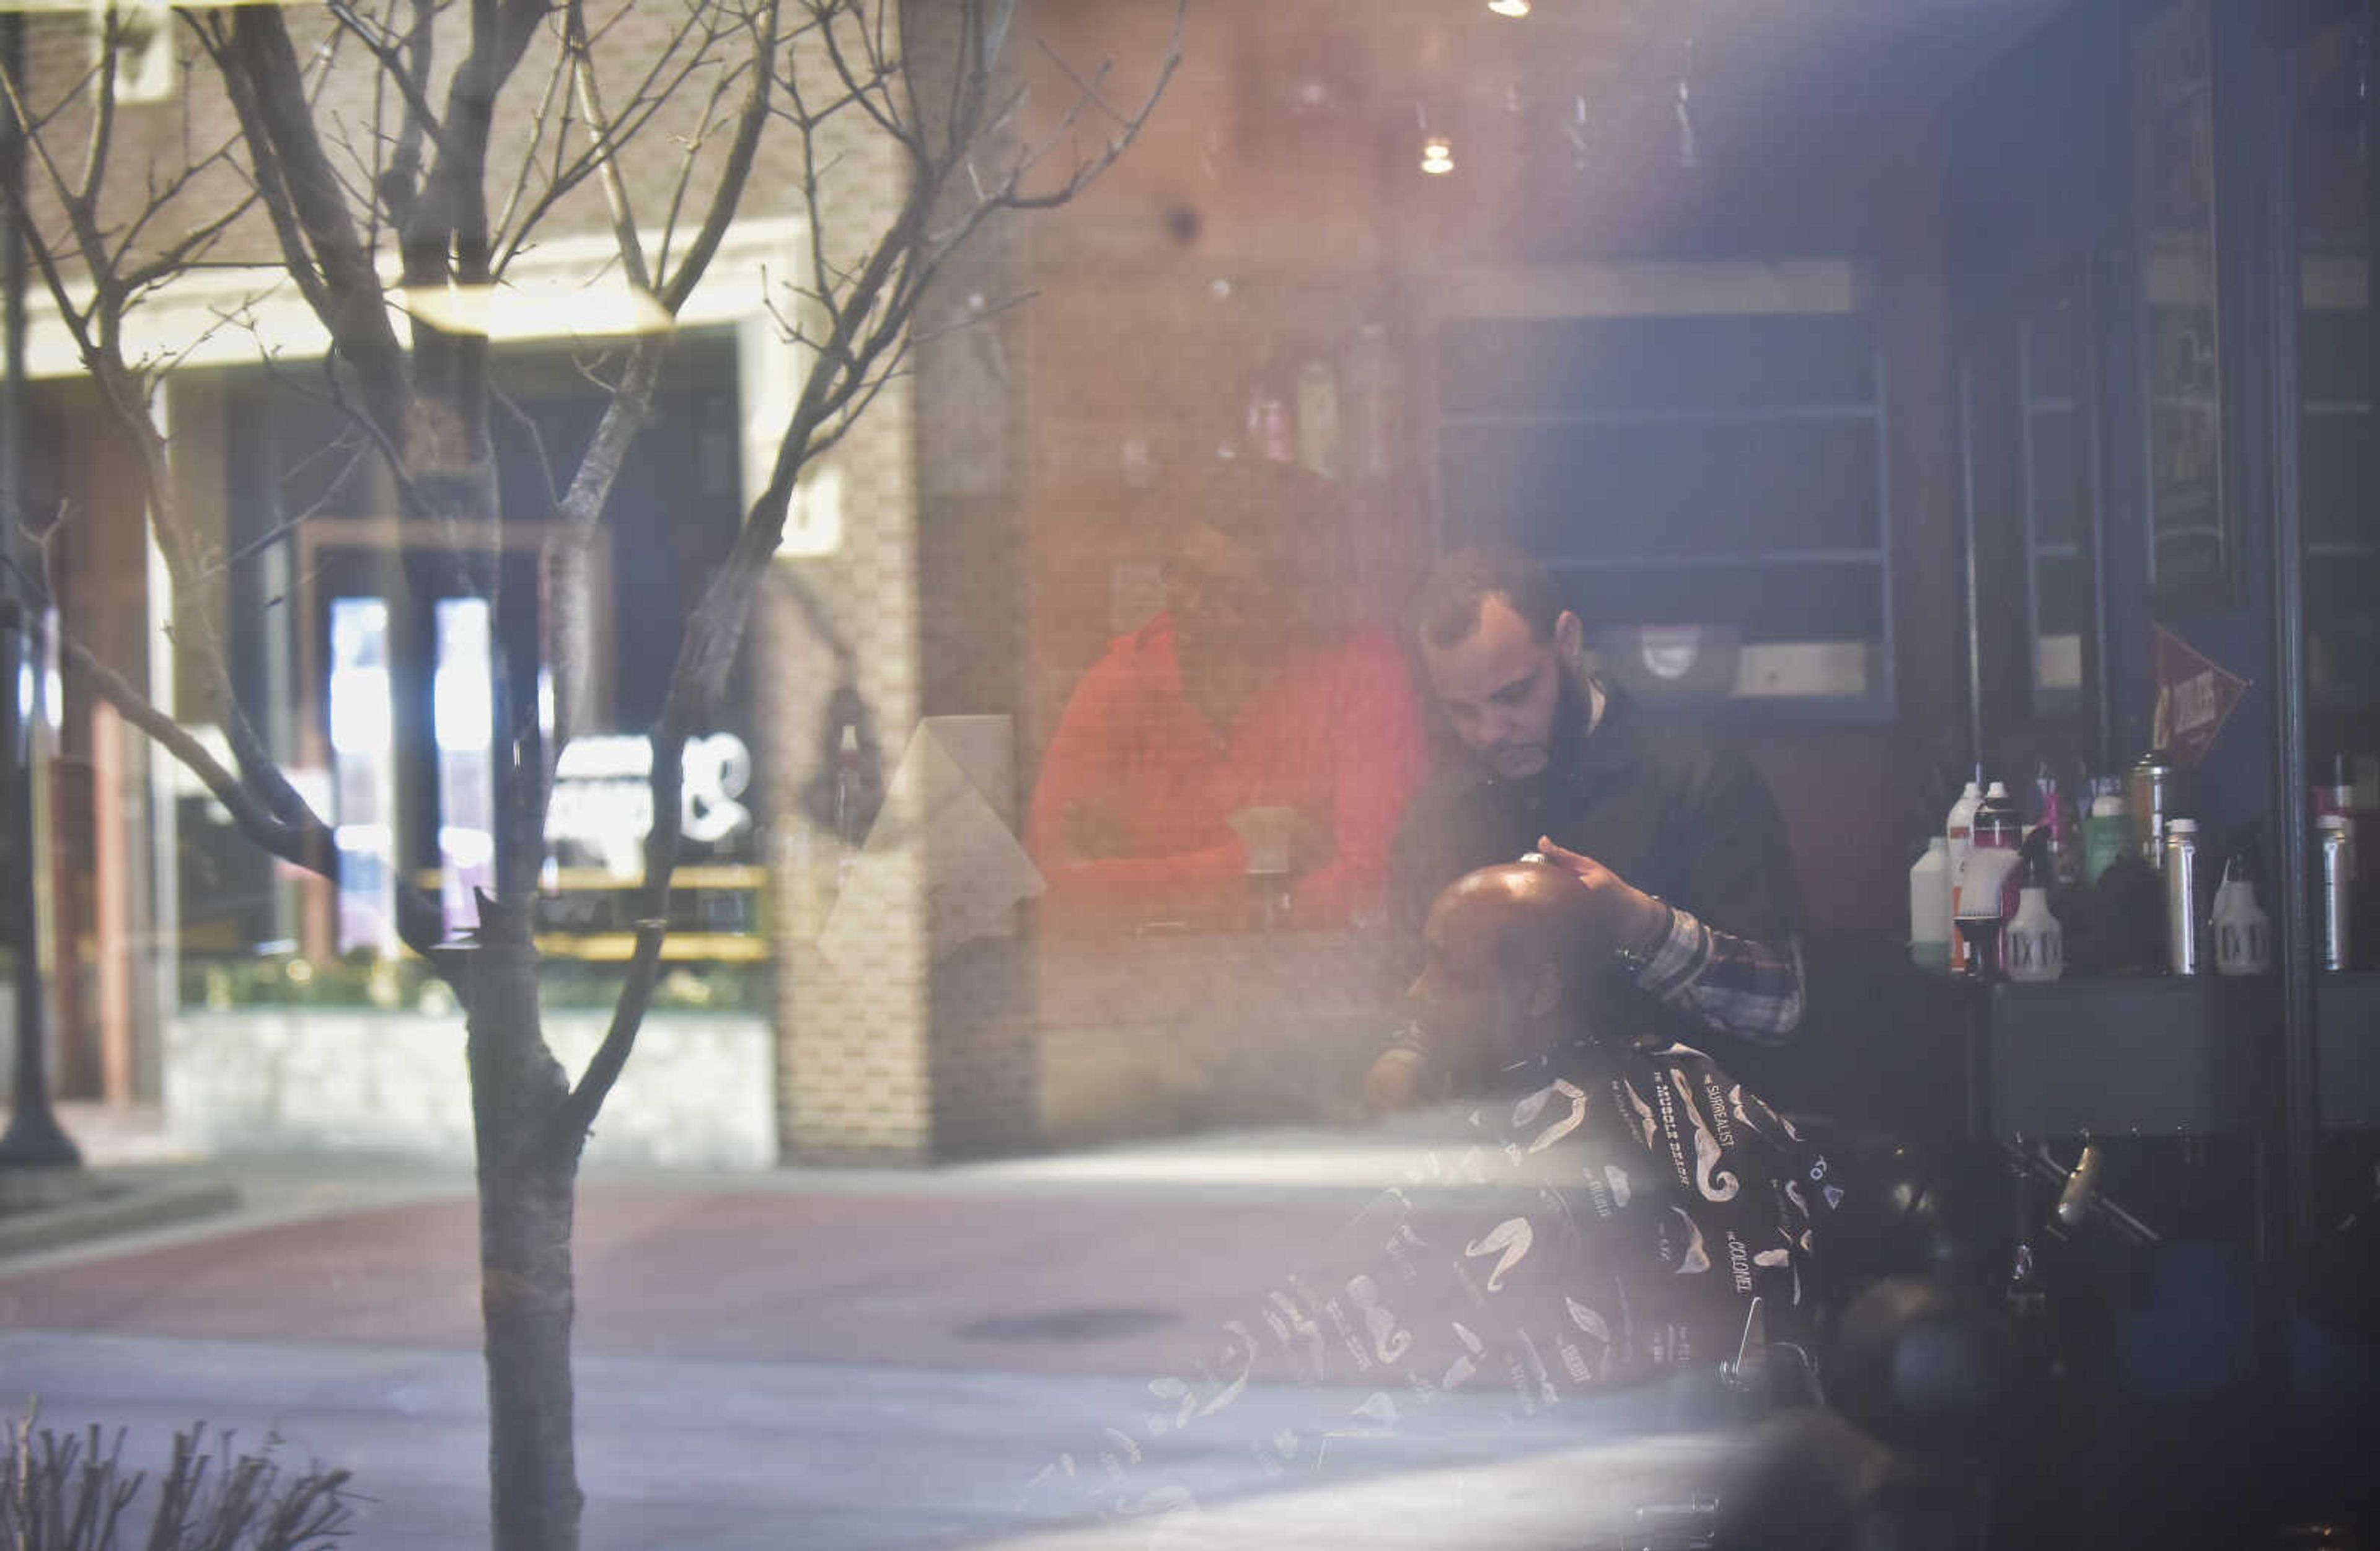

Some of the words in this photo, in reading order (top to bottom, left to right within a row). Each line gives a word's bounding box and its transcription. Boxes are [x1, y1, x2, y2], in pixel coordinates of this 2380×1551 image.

[1657, 1083, 1678, 1140] MUSCLE
[1708, 1084, 1734, 1148] SURREALIST
[1727, 1242, 1752, 1293] COLONEL
